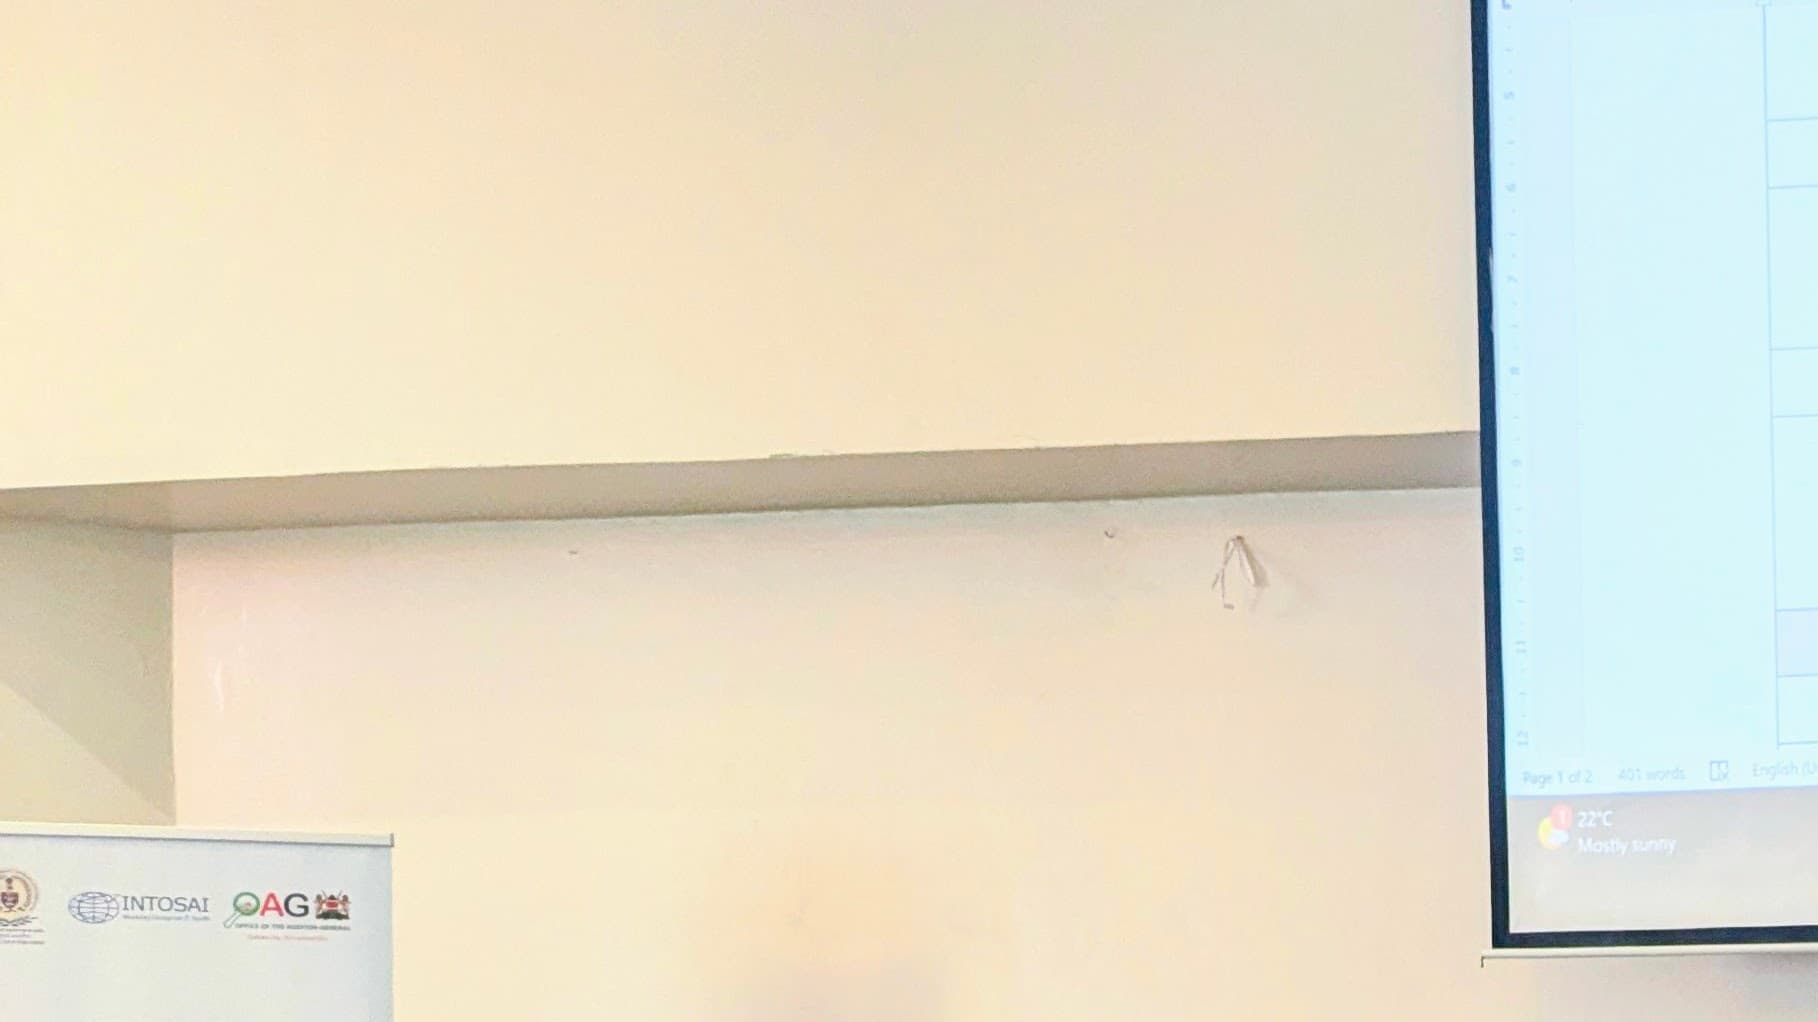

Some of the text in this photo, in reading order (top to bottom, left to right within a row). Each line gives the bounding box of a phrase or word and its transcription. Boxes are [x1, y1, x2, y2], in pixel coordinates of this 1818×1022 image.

[1522, 769, 1553, 789] Page
[1568, 768, 1582, 784] of
[1585, 768, 1594, 784] 2
[1645, 765, 1686, 782] words
[1753, 761, 1798, 780] English
[1577, 809, 1615, 828] 22°C
[1577, 837, 1678, 857] Mostly sunny
[122, 894, 209, 913] INTOSAI
[232, 891, 310, 918] OAG
